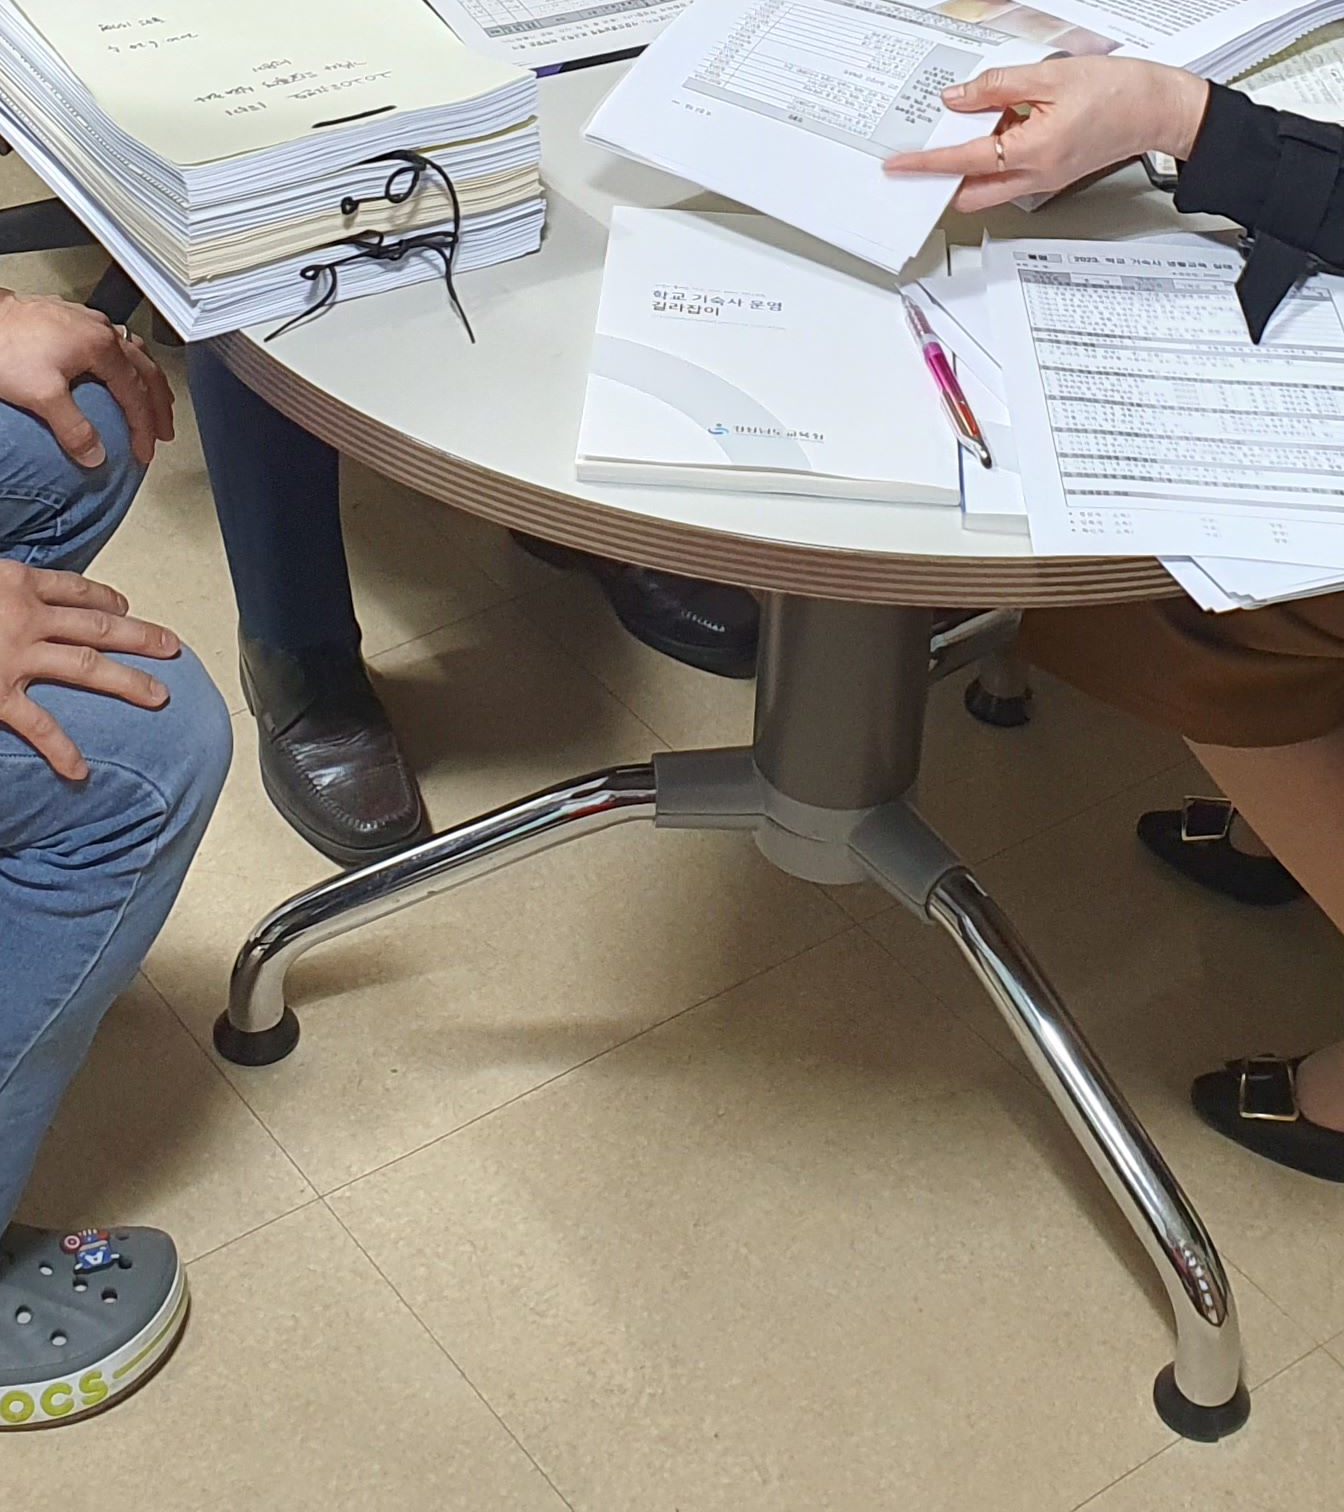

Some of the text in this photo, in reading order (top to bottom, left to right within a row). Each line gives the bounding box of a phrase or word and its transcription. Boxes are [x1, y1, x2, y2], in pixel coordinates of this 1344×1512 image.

[652, 301, 720, 317] 길라잡이
[653, 290, 783, 312] 학교 기숙사 운영
